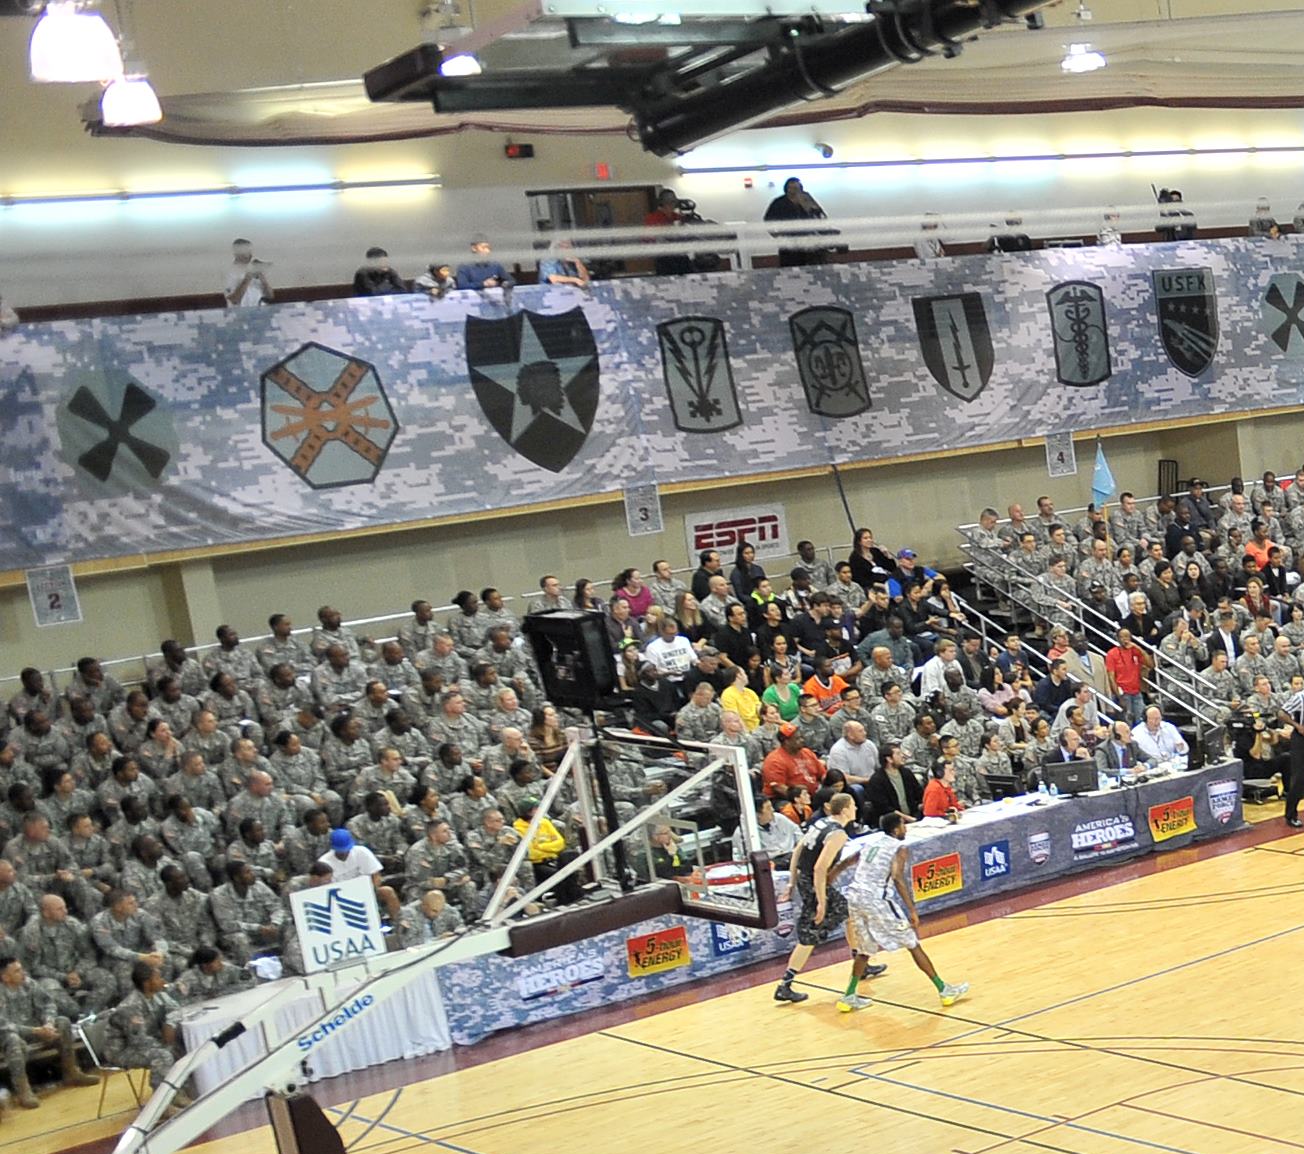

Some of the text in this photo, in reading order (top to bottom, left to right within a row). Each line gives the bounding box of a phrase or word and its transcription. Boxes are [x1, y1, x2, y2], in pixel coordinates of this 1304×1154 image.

[1056, 451, 1066, 464] 4
[639, 507, 650, 521] 3
[694, 515, 779, 550] ESPN
[47, 593, 62, 610] 2
[1075, 814, 1130, 832] AMERICA'S
[1071, 822, 1135, 848] HEROES
[984, 864, 1007, 877] USAA
[312, 934, 376, 965] USAA
[641, 950, 682, 969] ENERGY
[517, 958, 605, 997] HEROES
[298, 993, 375, 1051] Schelde
